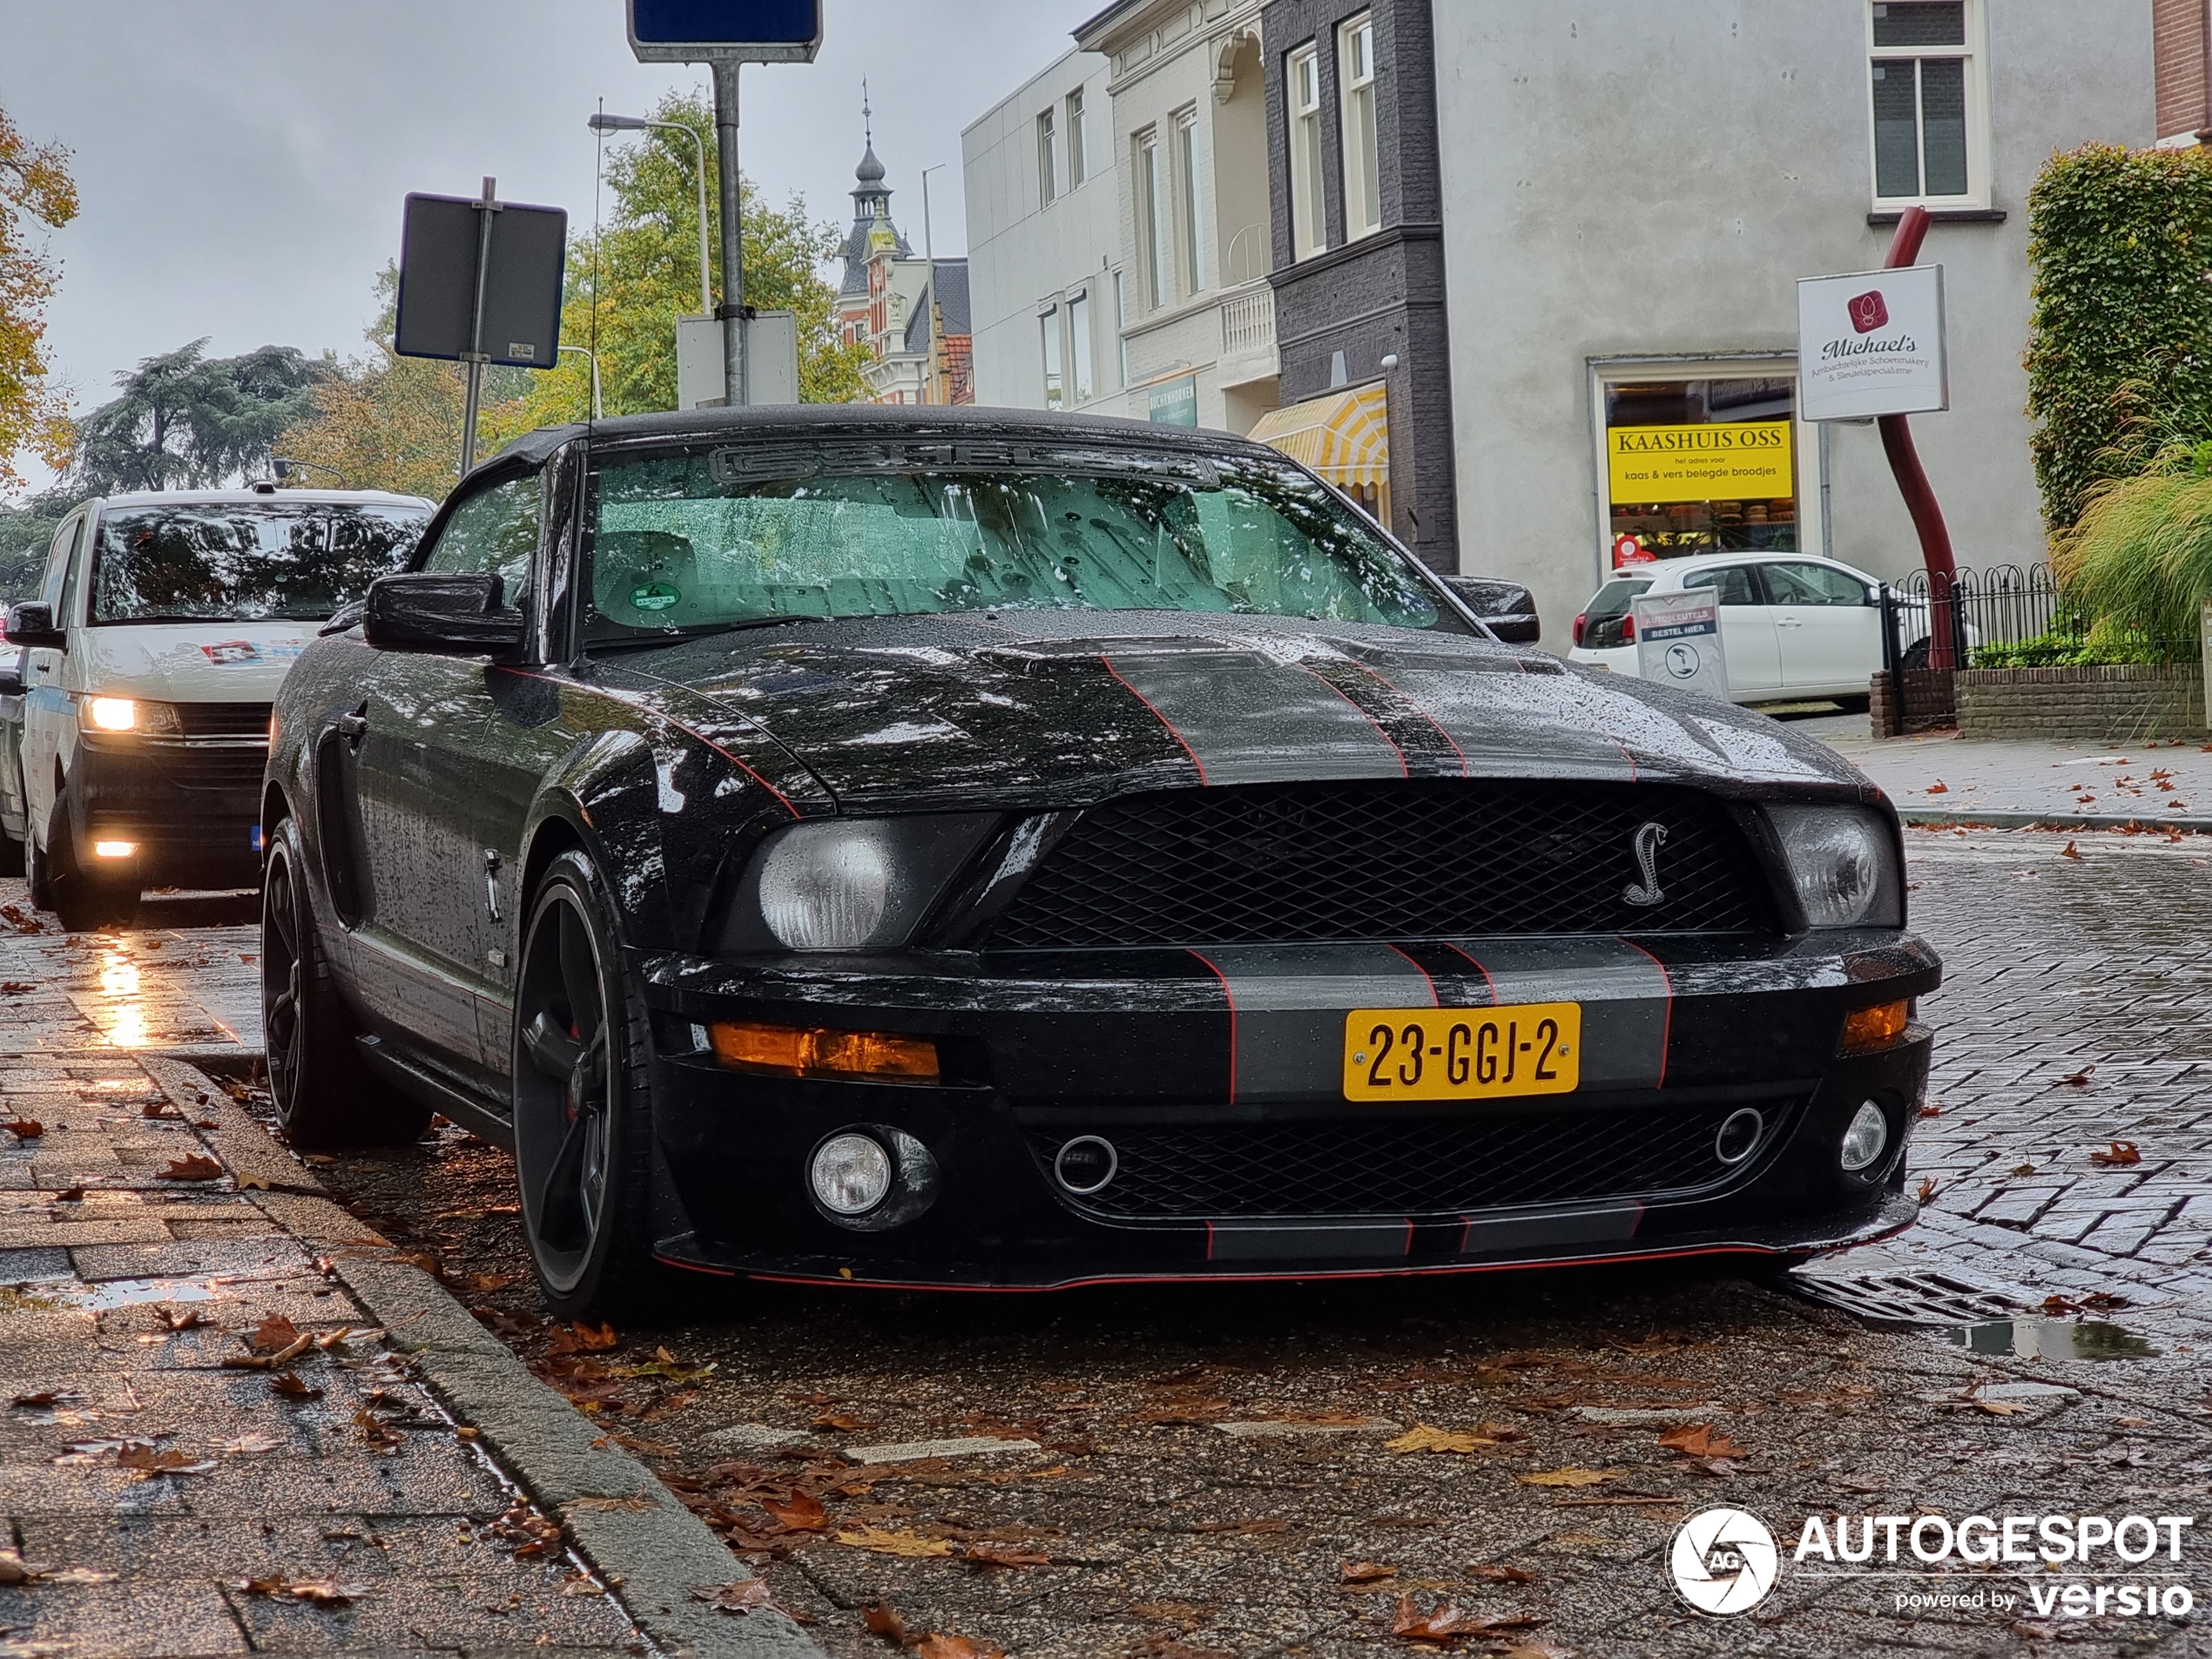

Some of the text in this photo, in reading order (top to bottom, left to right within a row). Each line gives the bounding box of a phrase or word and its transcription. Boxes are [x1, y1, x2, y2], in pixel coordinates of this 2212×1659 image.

[1821, 334, 1919, 361] Michael's
[1811, 355, 1930, 378] Ambachtelijke Schoenmakerij
[1829, 368, 1912, 382] & Sleutelspecialisme
[1618, 428, 1782, 451] KAASHUIS OSS
[1624, 466, 1777, 481] kaas & vers belegde broodjes
[1645, 610, 1709, 625] AUTOSLEUTELS
[1651, 624, 1705, 638] BESTEL HIER
[1367, 1017, 1560, 1087] 23-GGJ-2
